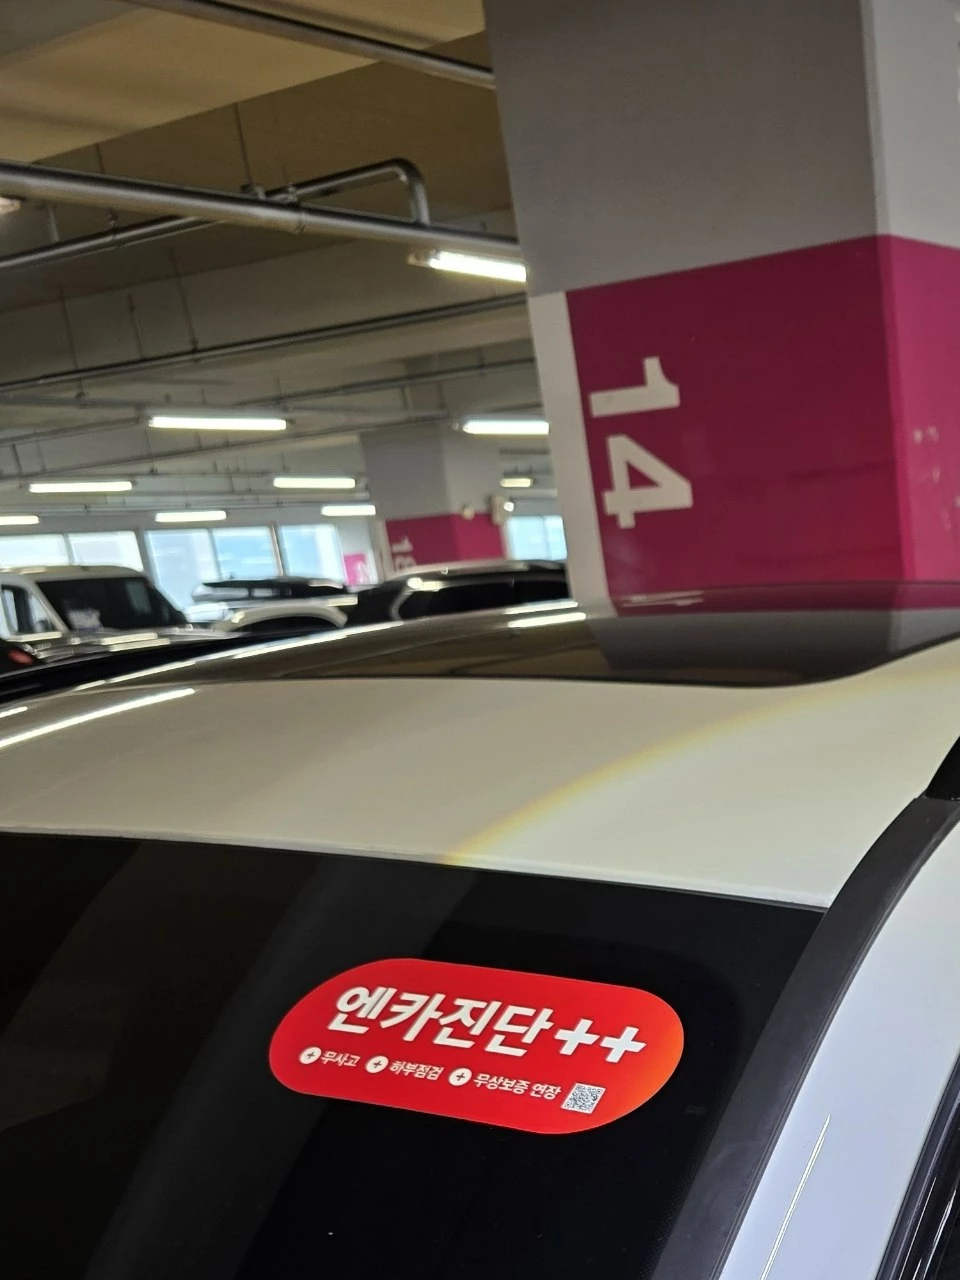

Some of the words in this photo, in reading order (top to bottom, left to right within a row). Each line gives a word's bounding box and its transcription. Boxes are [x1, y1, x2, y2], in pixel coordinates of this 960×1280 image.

[588, 356, 694, 529] 14
[321, 1050, 361, 1067] 무사고
[389, 1060, 445, 1081] 하부점검
[473, 1073, 530, 1095] 무상보증
[530, 1083, 562, 1100] 연장
